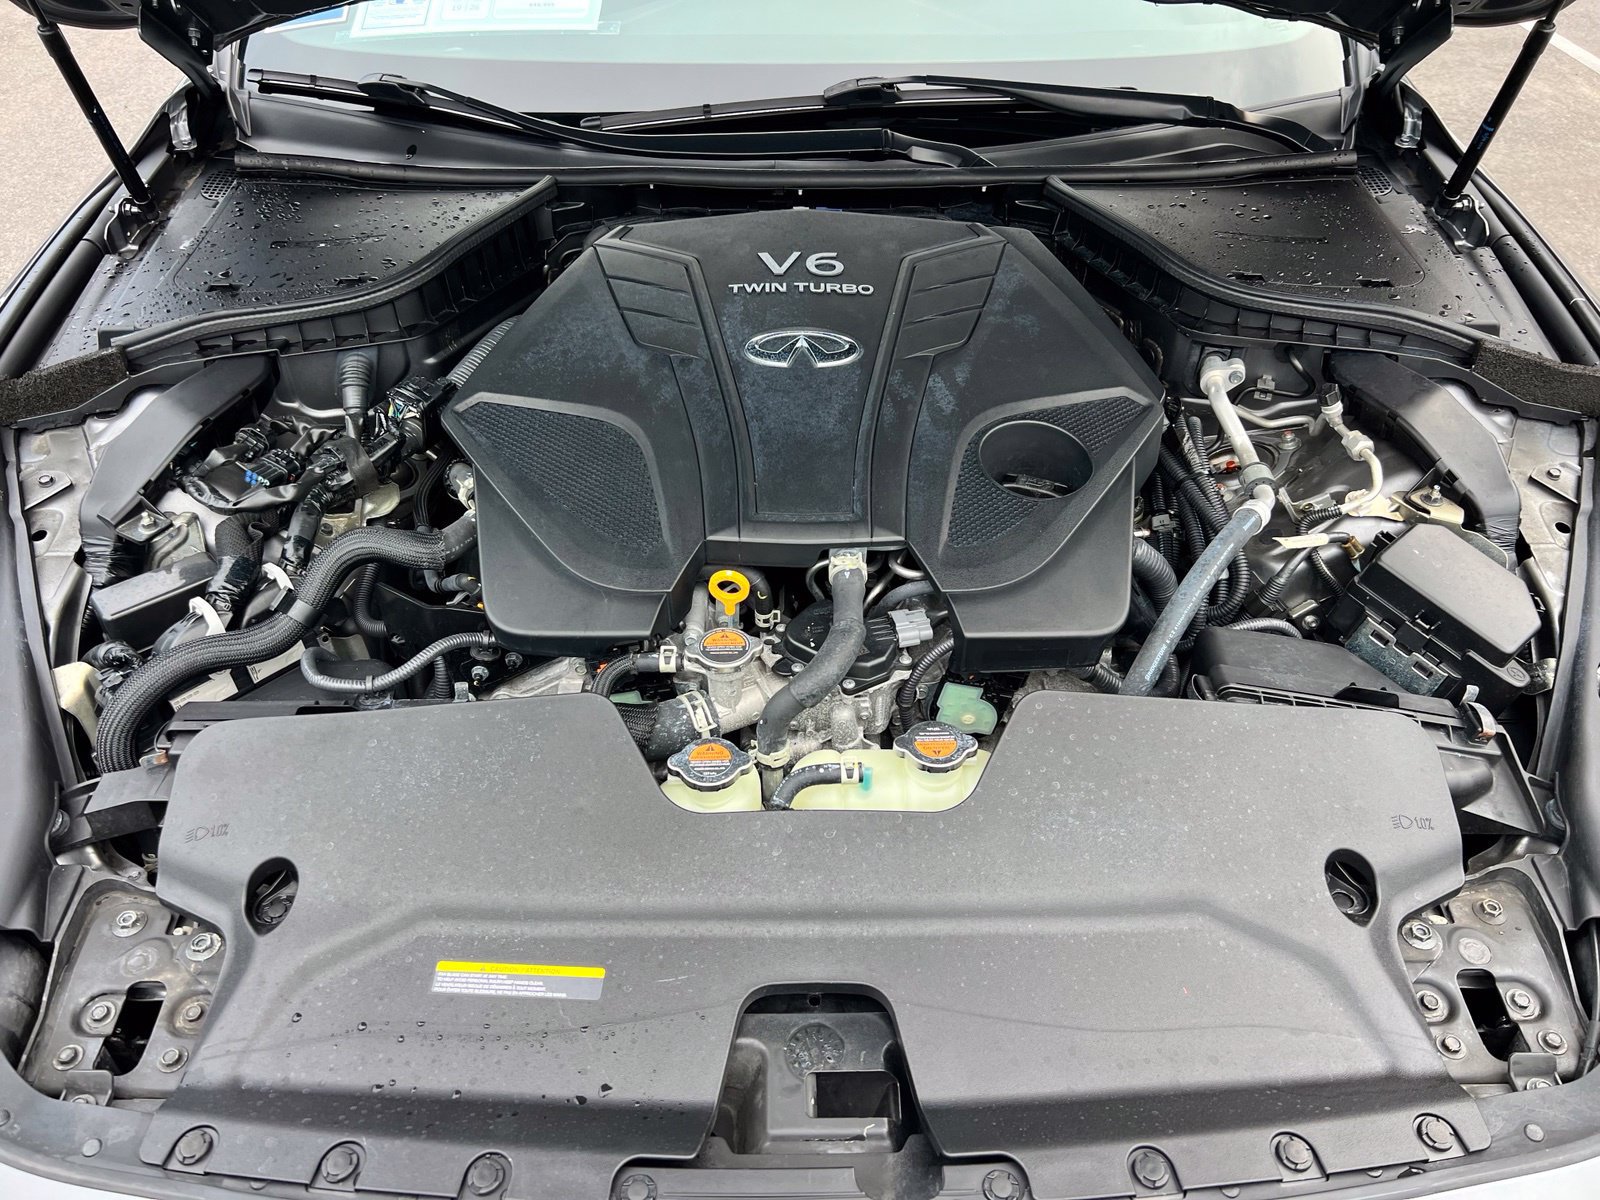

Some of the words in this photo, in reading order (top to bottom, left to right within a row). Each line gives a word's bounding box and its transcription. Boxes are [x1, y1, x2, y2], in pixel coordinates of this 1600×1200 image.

[757, 251, 845, 277] V6
[728, 281, 787, 294] TWIN
[793, 282, 875, 296] TURBO
[1144, 643, 1167, 681] BRIDGESTONE
[526, 967, 561, 975] ATTENTION
